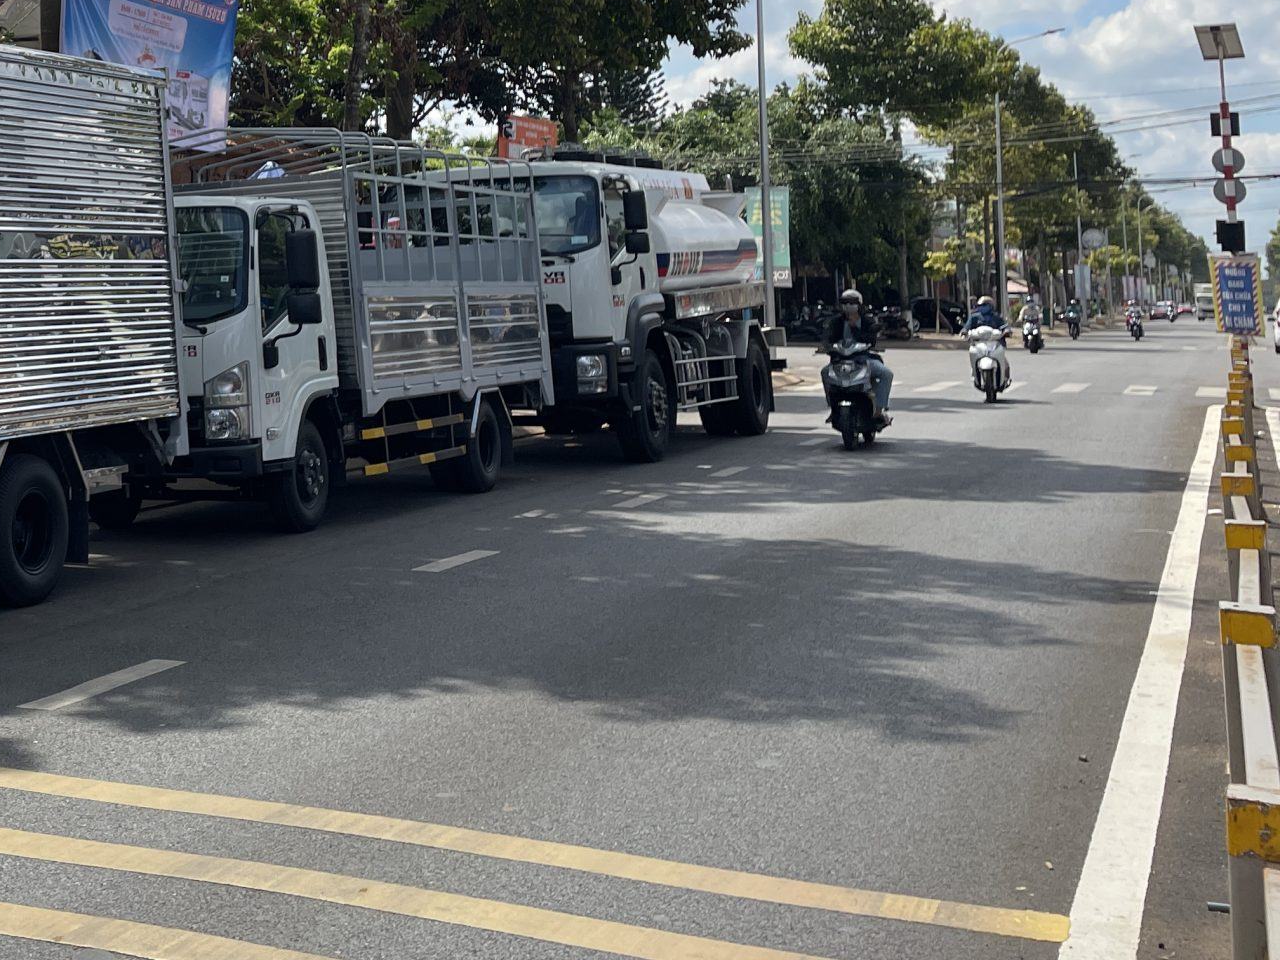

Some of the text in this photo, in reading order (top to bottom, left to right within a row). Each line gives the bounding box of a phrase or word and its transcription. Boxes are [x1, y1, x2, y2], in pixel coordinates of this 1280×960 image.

[205, 5, 227, 25] ISUZU
[265, 390, 280, 399] QKR
[266, 397, 280, 405] 210
